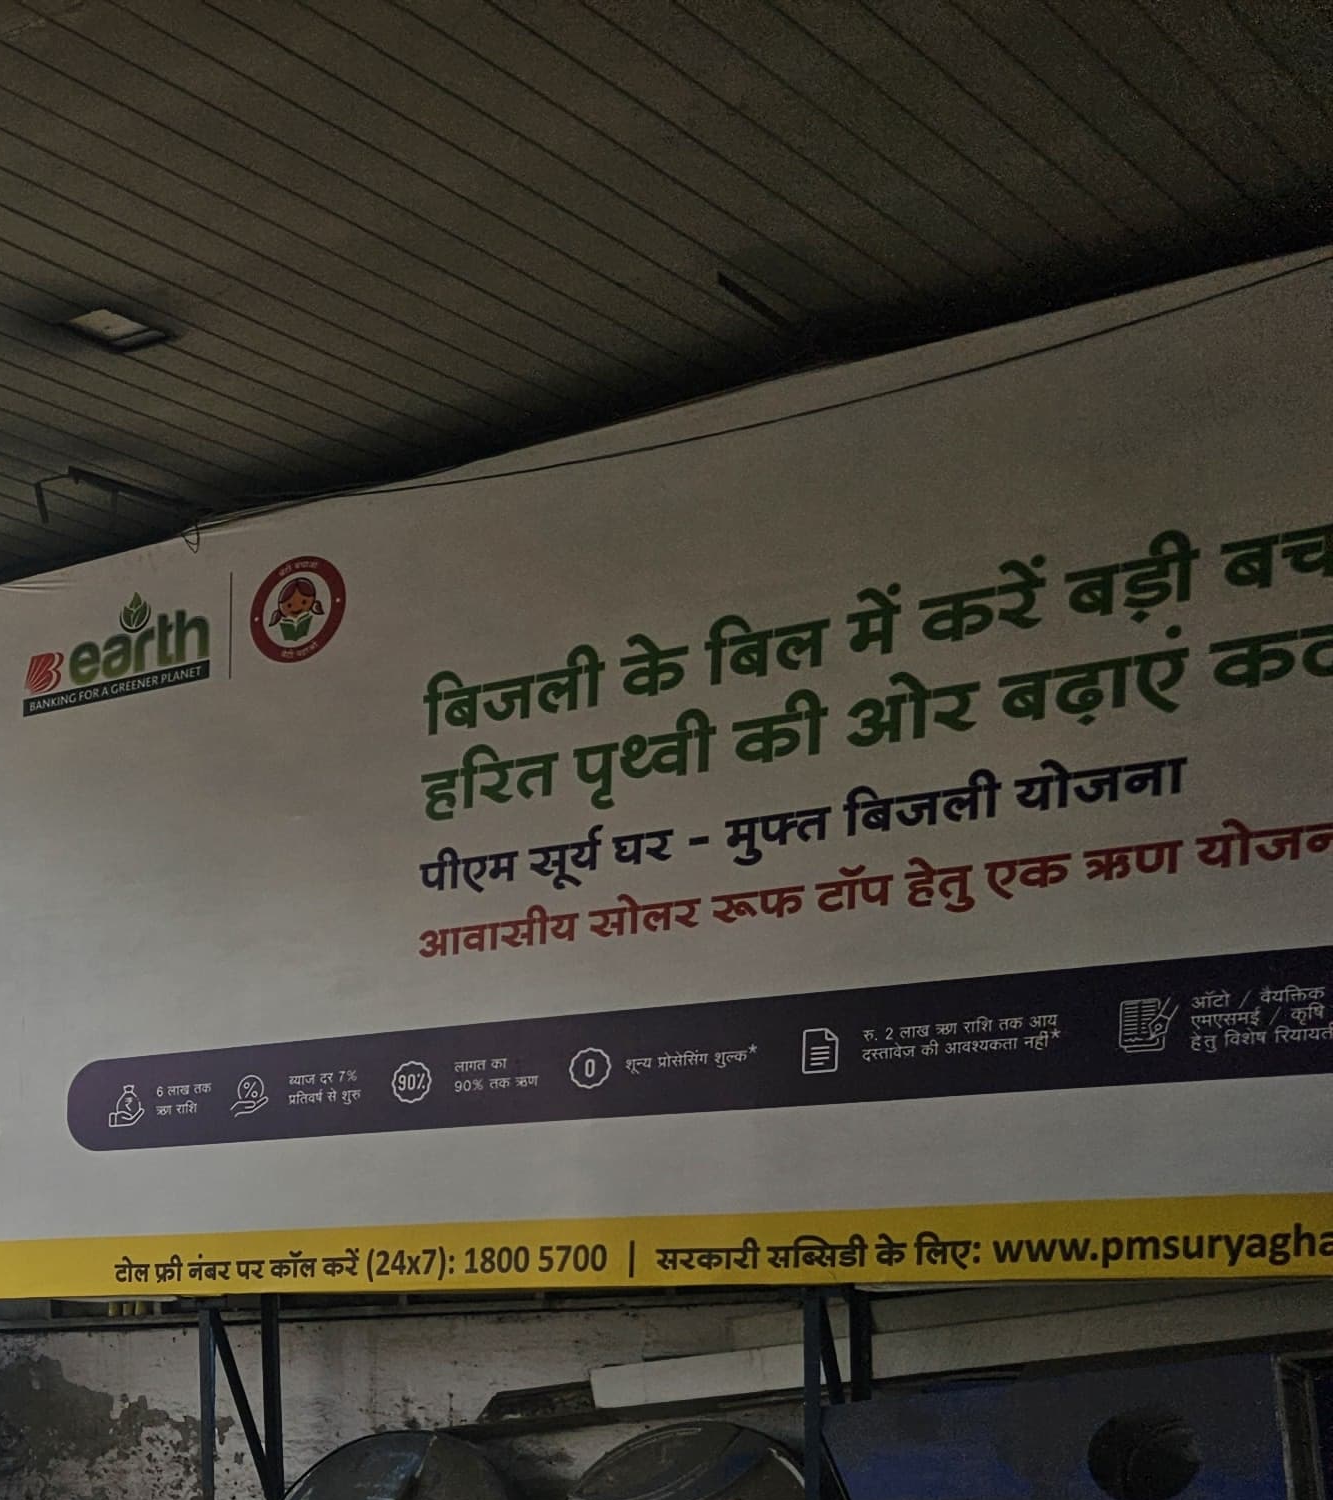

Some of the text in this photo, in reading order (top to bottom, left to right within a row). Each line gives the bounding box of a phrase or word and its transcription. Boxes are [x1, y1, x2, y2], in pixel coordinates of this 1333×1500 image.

[423, 645, 605, 735] बिजली
[620, 634, 689, 696] के
[705, 615, 830, 685] बिल
[847, 583, 901, 654] में
[919, 554, 1046, 641] करें
[1065, 529, 1200, 623] बड़ी
[30, 666, 200, 710] BANKING FOR A GREENER PLANET
[421, 744, 559, 820] हरित
[573, 709, 717, 809] पृथ्वी
[732, 689, 828, 763] की
[847, 672, 980, 747] ओर
[999, 625, 1189, 726] बढ़ाएं
[420, 847, 519, 893] पीएम
[529, 825, 603, 889] सूर्य
[612, 829, 673, 864] घर
[725, 806, 832, 865] मुफ्त
[843, 769, 1002, 836] बिजली
[1014, 757, 1187, 810] योजना
[419, 905, 579, 957] आवासीय
[589, 894, 701, 937] सोलर
[711, 885, 805, 923] रूफ
[815, 865, 893, 912] टॉप
[904, 857, 975, 913] हेतु
[985, 853, 1072, 899] एक
[1083, 840, 1183, 880] ऋण
[1192, 990, 1230, 1008] ऑटो
[1291, 1002, 1325, 1025] कृषि
[886, 1027, 893, 1040] 2
[900, 1025, 930, 1038] लाख
[935, 1023, 957, 1035] ऋण
[963, 1016, 993, 1033] राशि
[999, 1017, 1023, 1030] तक
[1029, 1015, 1058, 1027] आय
[862, 1043, 915, 1061] दस्तावेज
[921, 1039, 938, 1056] की
[945, 1038, 1018, 1054] आवश्यकता
[1191, 1032, 1217, 1053] हेतु
[1224, 1028, 1267, 1046] विशेष
[455, 1058, 507, 1072] लागत का
[626, 1058, 652, 1074] शून्य
[658, 1050, 708, 1067] प्रोसेसिंग
[289, 1070, 357, 1085] ब्याज दर 7%
[398, 1073, 425, 1091] 90%
[455, 1076, 538, 1092] 90% तक ऋण
[157, 1083, 211, 1097] 6 लाख तक
[327, 1088, 337, 1101] से
[156, 1100, 197, 1115] ऋण राशि
[655, 1237, 760, 1270] सरकारी
[766, 1234, 868, 1268] सब्सिडी
[875, 1233, 907, 1266] के
[914, 1230, 981, 1268] लिए:
[114, 1256, 150, 1282] टोल
[155, 1255, 183, 1283] फ्री
[187, 1255, 231, 1280] नंबर
[236, 1260, 265, 1279] पर
[269, 1251, 317, 1278] कॉल
[322, 1248, 359, 1277] करें
[367, 1246, 454, 1282] (24x7):
[465, 1246, 529, 1273] 1800
[538, 1244, 607, 1272] 5700
